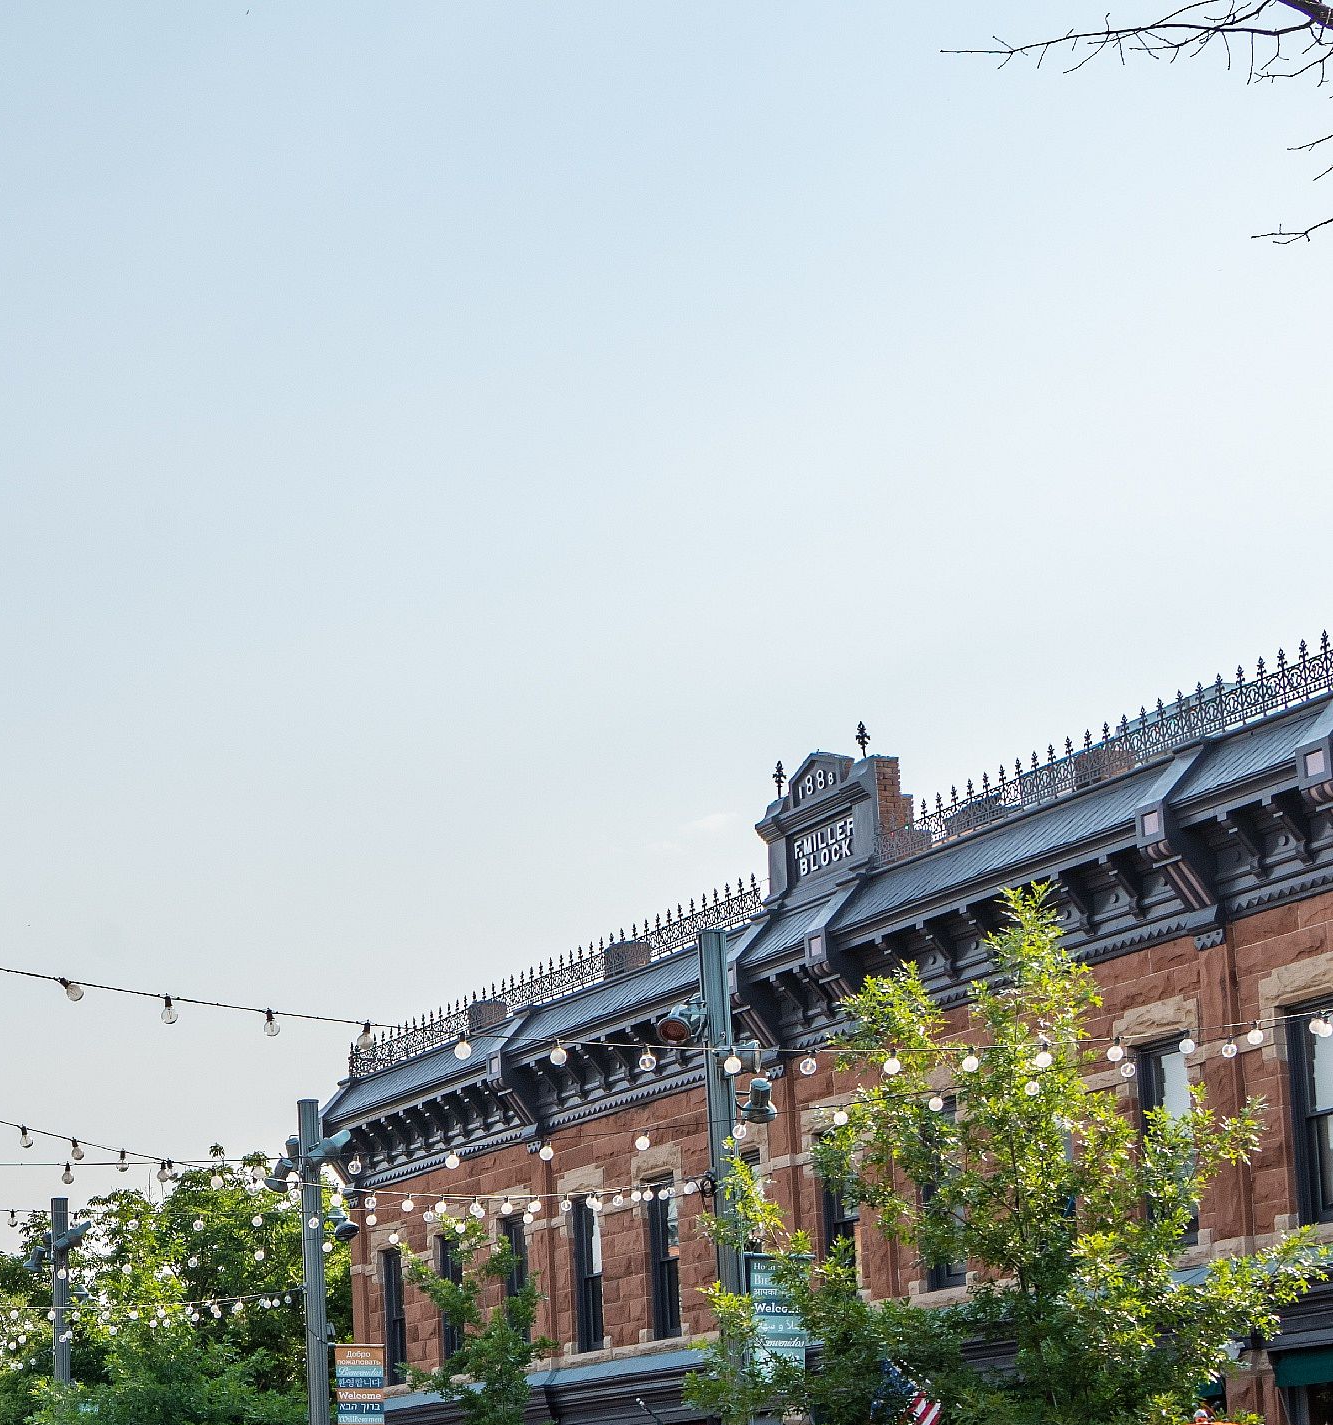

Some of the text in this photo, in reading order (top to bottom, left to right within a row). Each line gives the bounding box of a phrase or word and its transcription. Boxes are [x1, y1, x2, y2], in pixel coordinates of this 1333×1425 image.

[799, 770, 834, 799] 1888
[800, 839, 851, 876] BLOCK
[346, 1350, 371, 1359] Добро
[338, 1391, 382, 1400] Welcome
[339, 1403, 381, 1413] ברוך הבא
